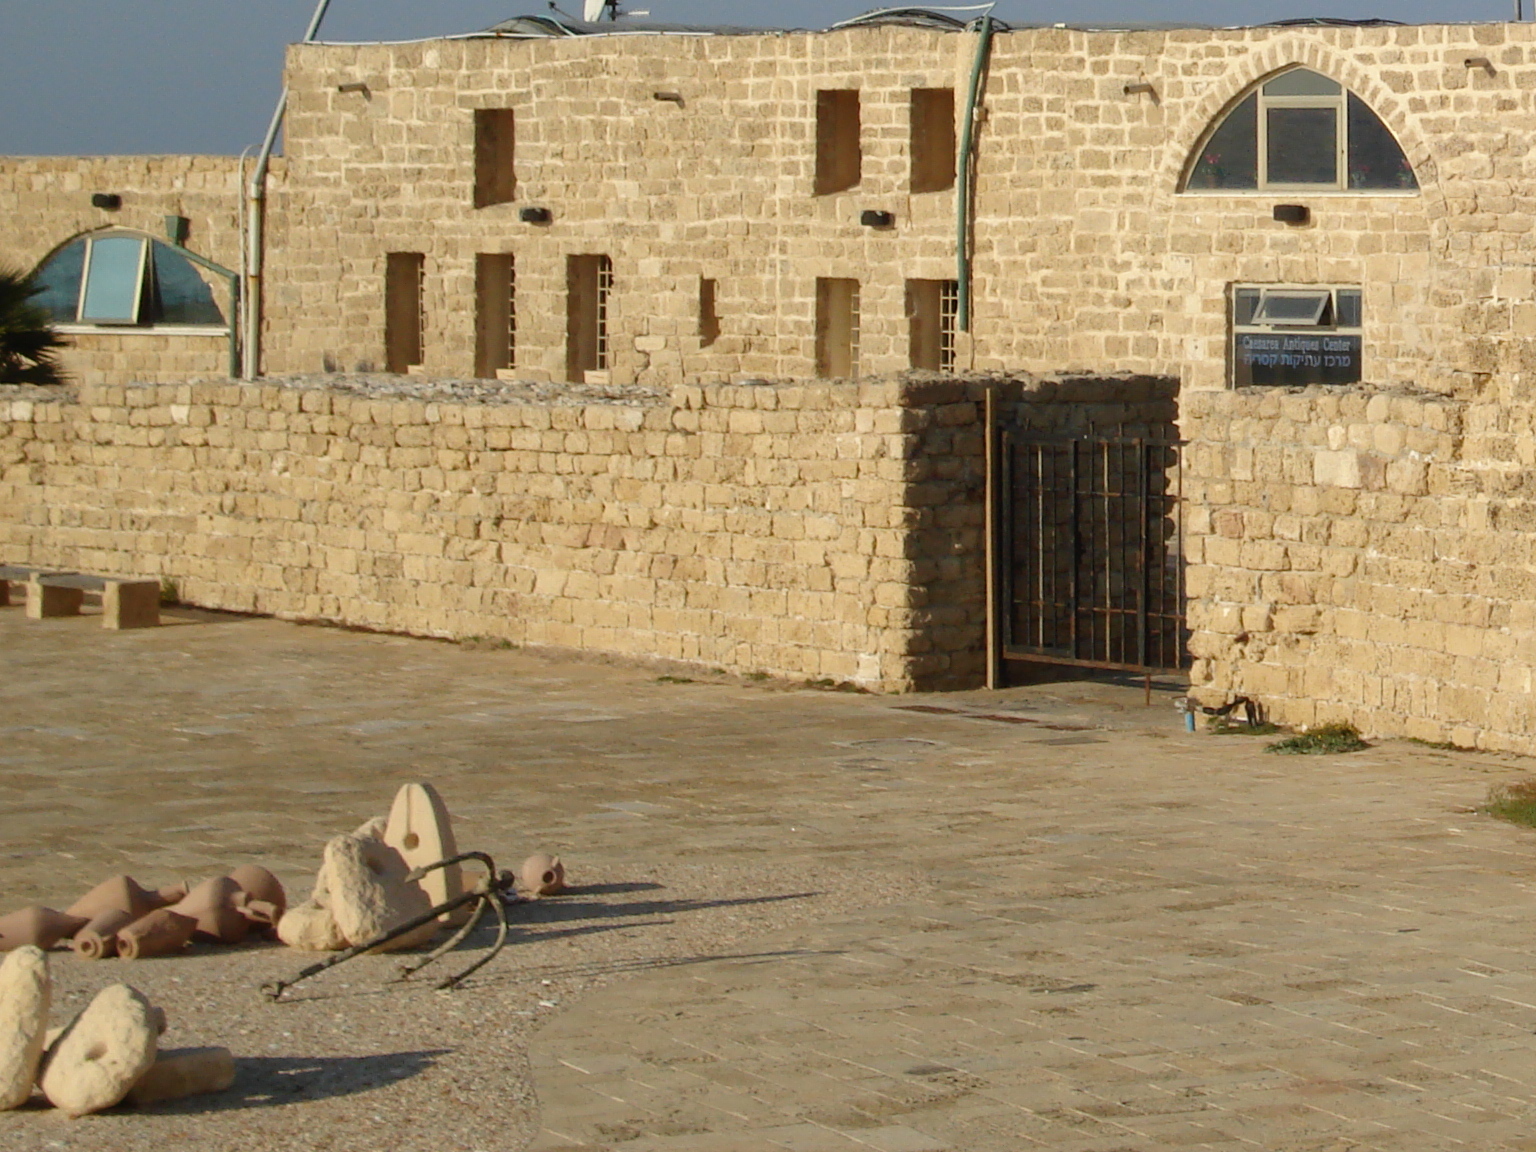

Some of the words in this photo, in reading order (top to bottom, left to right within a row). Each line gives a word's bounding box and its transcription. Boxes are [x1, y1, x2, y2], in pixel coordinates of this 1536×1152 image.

[1243, 336, 1279, 349] Caesarea
[1282, 337, 1319, 353] Antiques
[1323, 338, 1350, 351] Center
[1244, 354, 1278, 368] קסריה
[1280, 354, 1321, 368] עתיקות
[1323, 354, 1351, 367] מרכז
